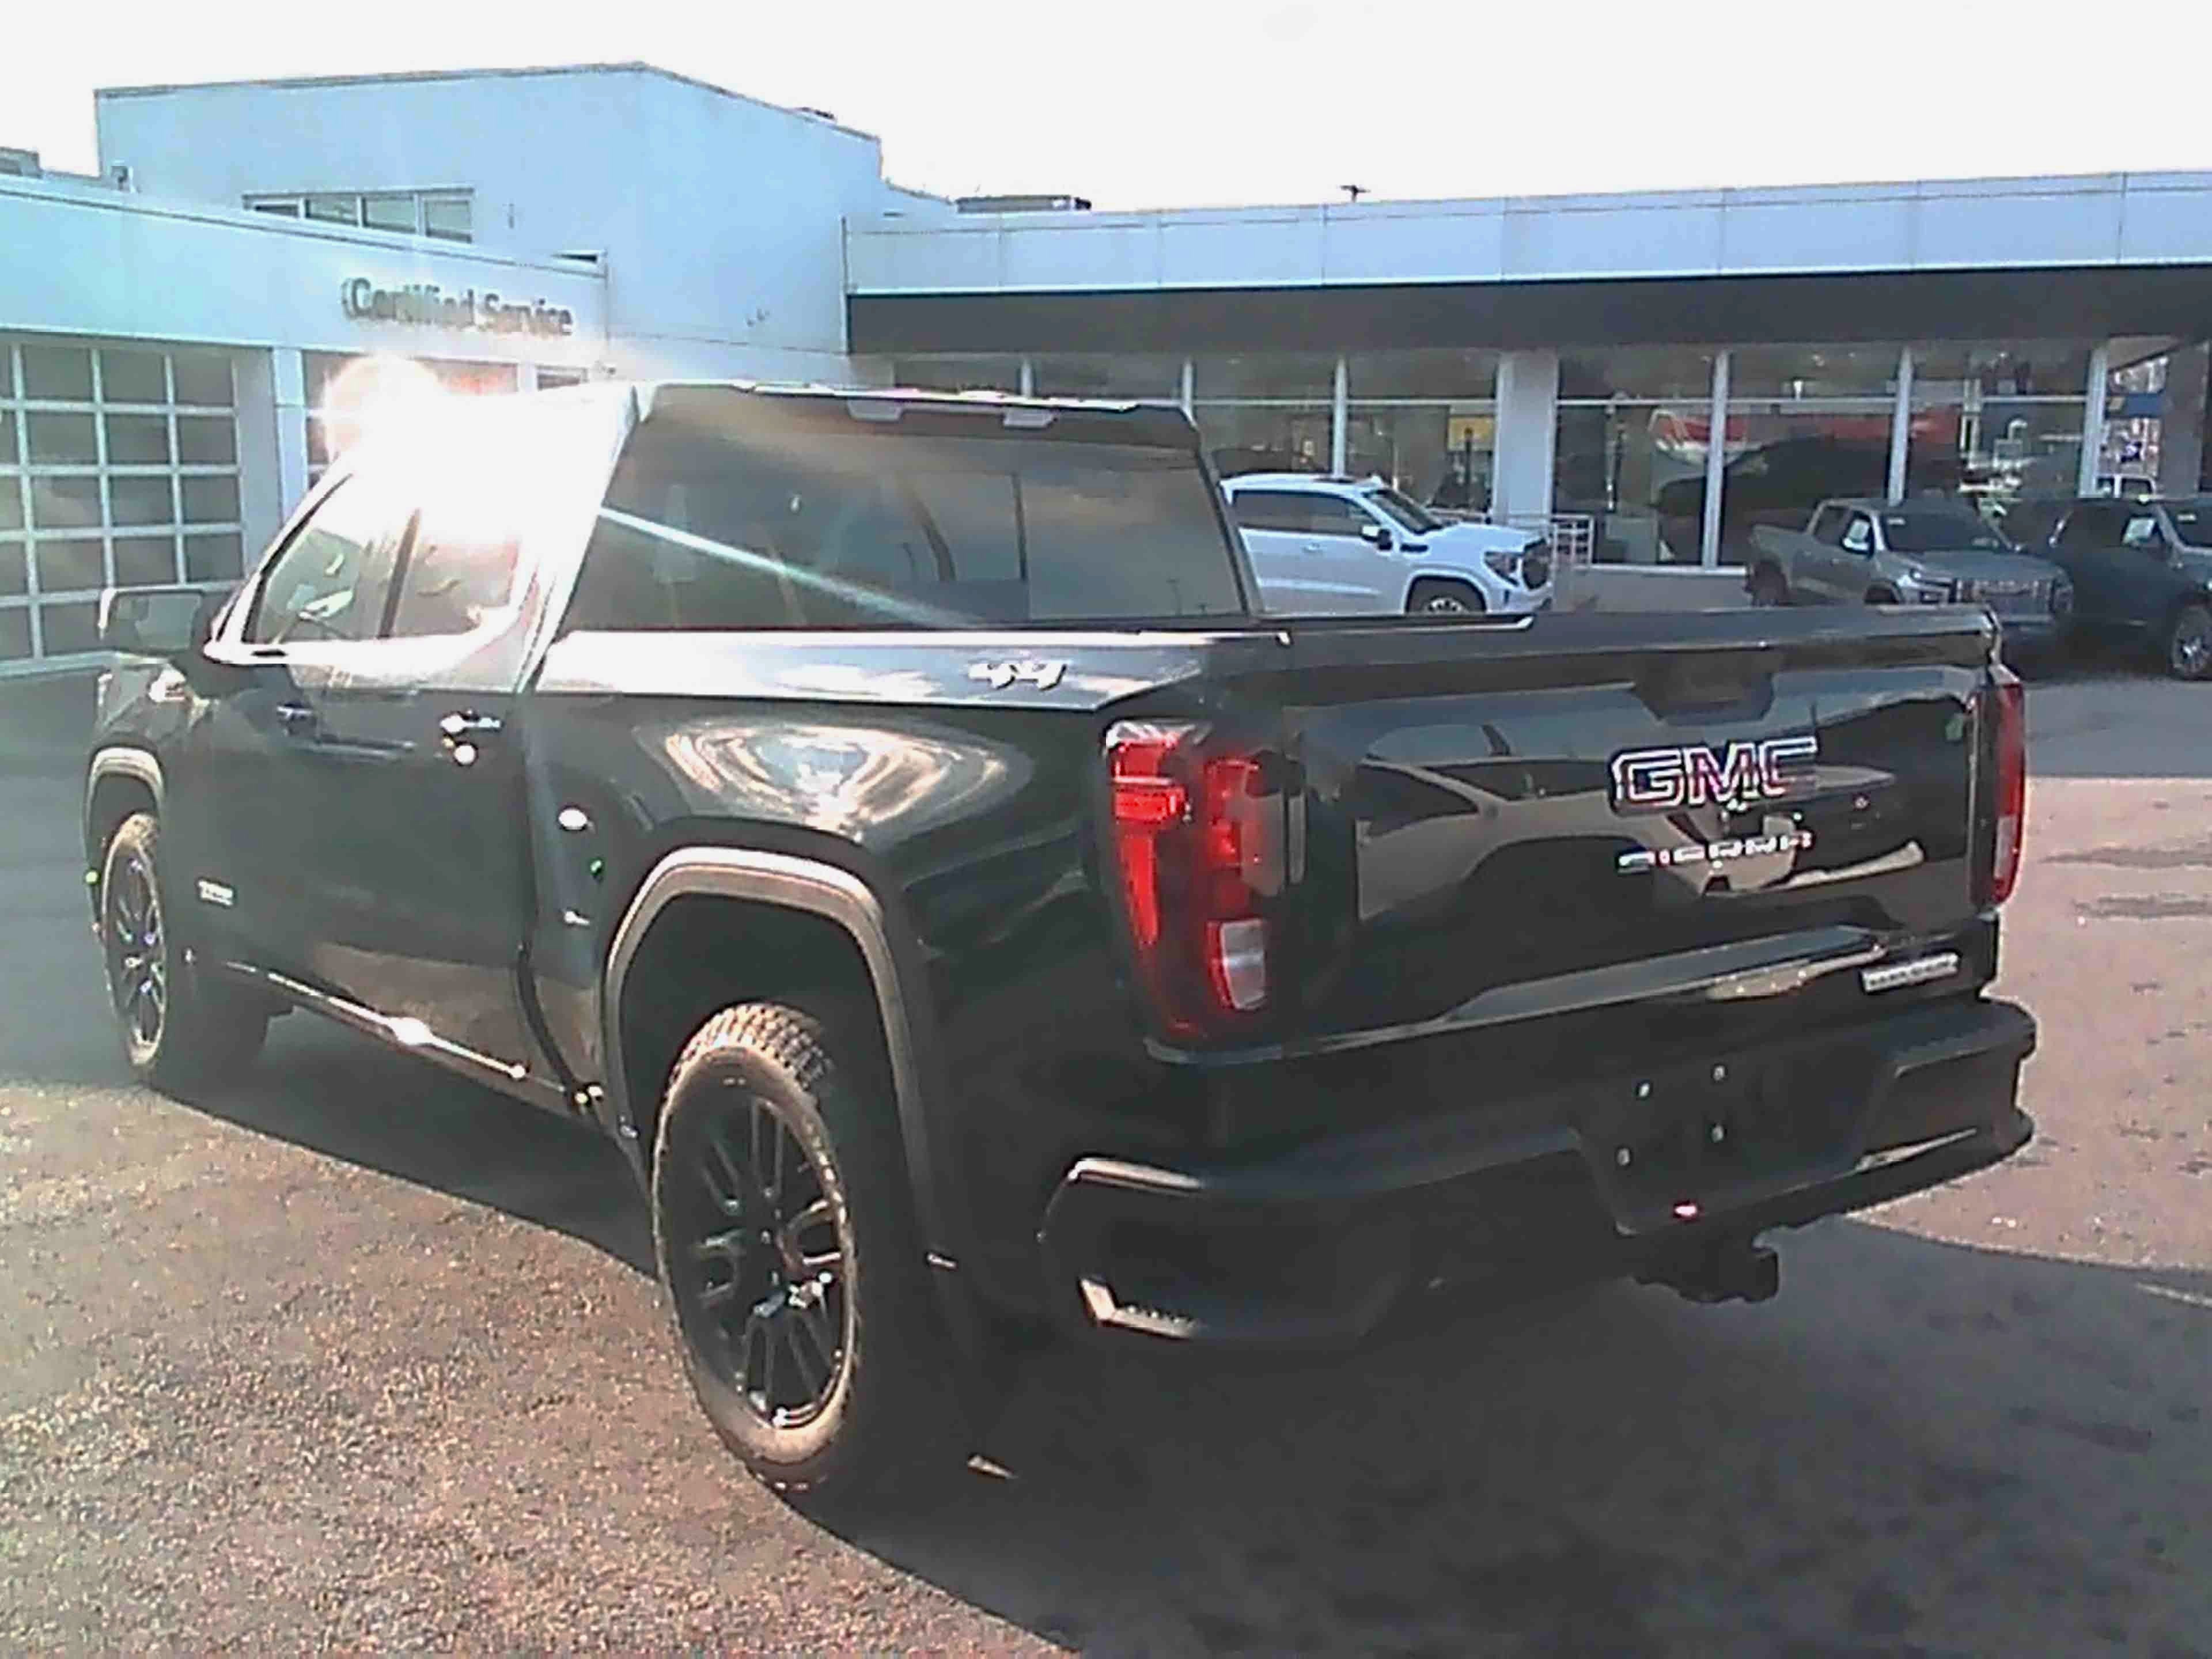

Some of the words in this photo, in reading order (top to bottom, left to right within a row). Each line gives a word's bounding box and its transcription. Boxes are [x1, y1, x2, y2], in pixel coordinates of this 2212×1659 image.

[343, 277, 475, 327] Certified
[482, 293, 573, 336] Service
[1611, 736, 1819, 810] GMC
